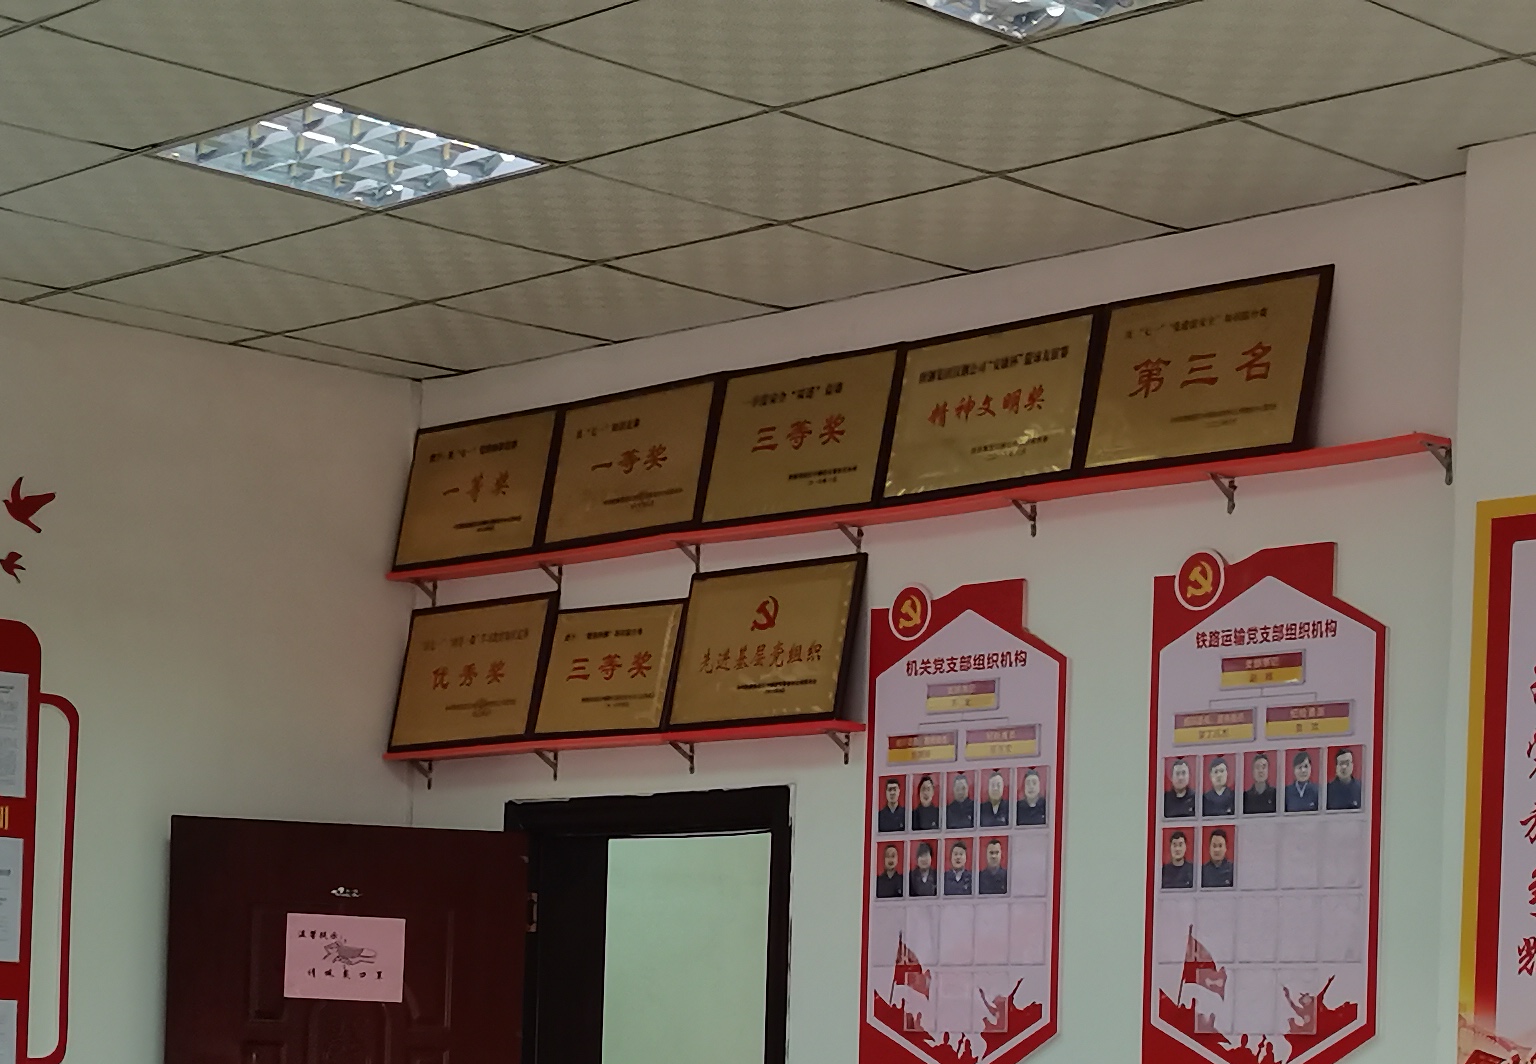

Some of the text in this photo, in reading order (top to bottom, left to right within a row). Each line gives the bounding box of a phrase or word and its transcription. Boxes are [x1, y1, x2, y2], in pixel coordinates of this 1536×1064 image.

[1128, 341, 1272, 398] 第三名
[927, 384, 1045, 428] 精神文明奖
[751, 413, 846, 453] 三等奖
[1196, 619, 1338, 650] 铁路运输党支部组织机构
[566, 650, 652, 681] 三等奖
[699, 640, 822, 674] 先进基层党组织
[906, 650, 1028, 677] 机关党支部组织机构
[431, 660, 505, 690] 优秀奖
